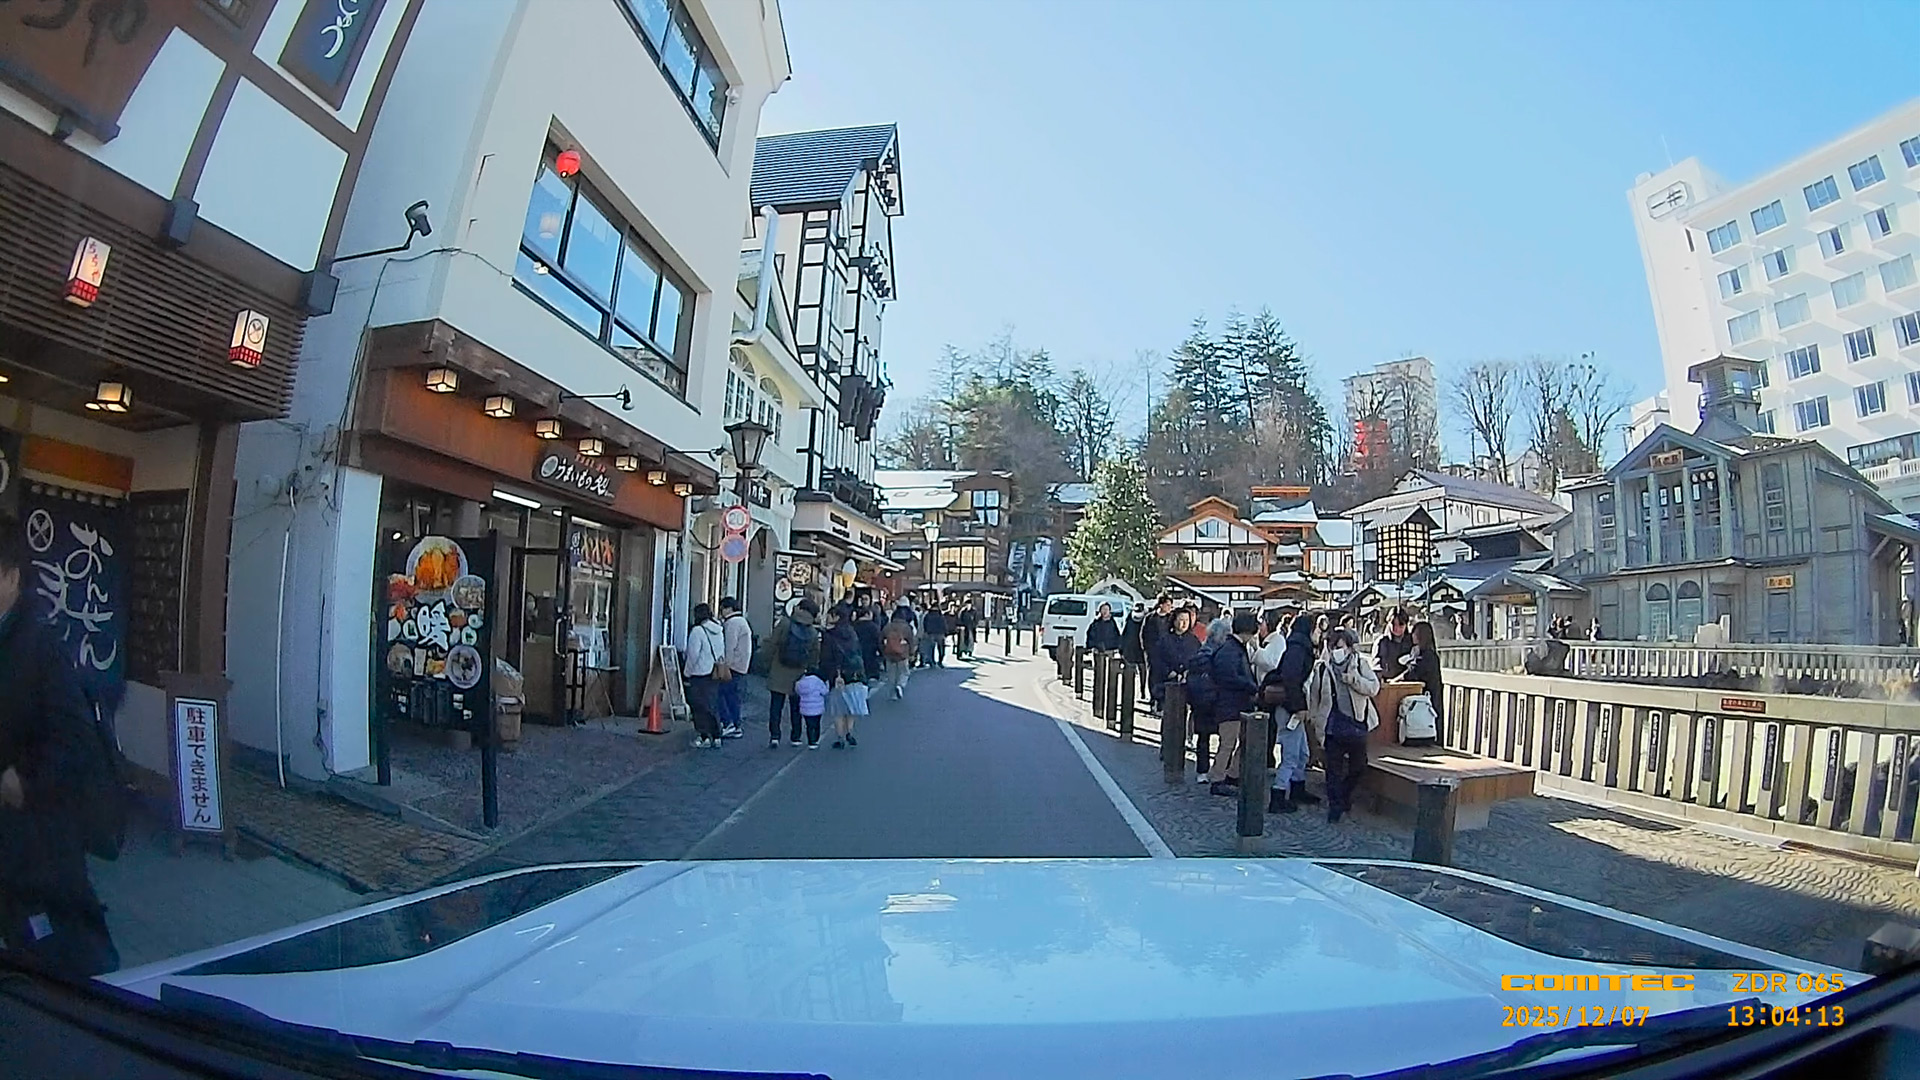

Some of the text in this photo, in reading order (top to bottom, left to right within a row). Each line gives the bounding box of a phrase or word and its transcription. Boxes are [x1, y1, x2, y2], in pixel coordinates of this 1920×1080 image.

[728, 512, 745, 526] 20
[185, 706, 212, 825] 駐車できません
